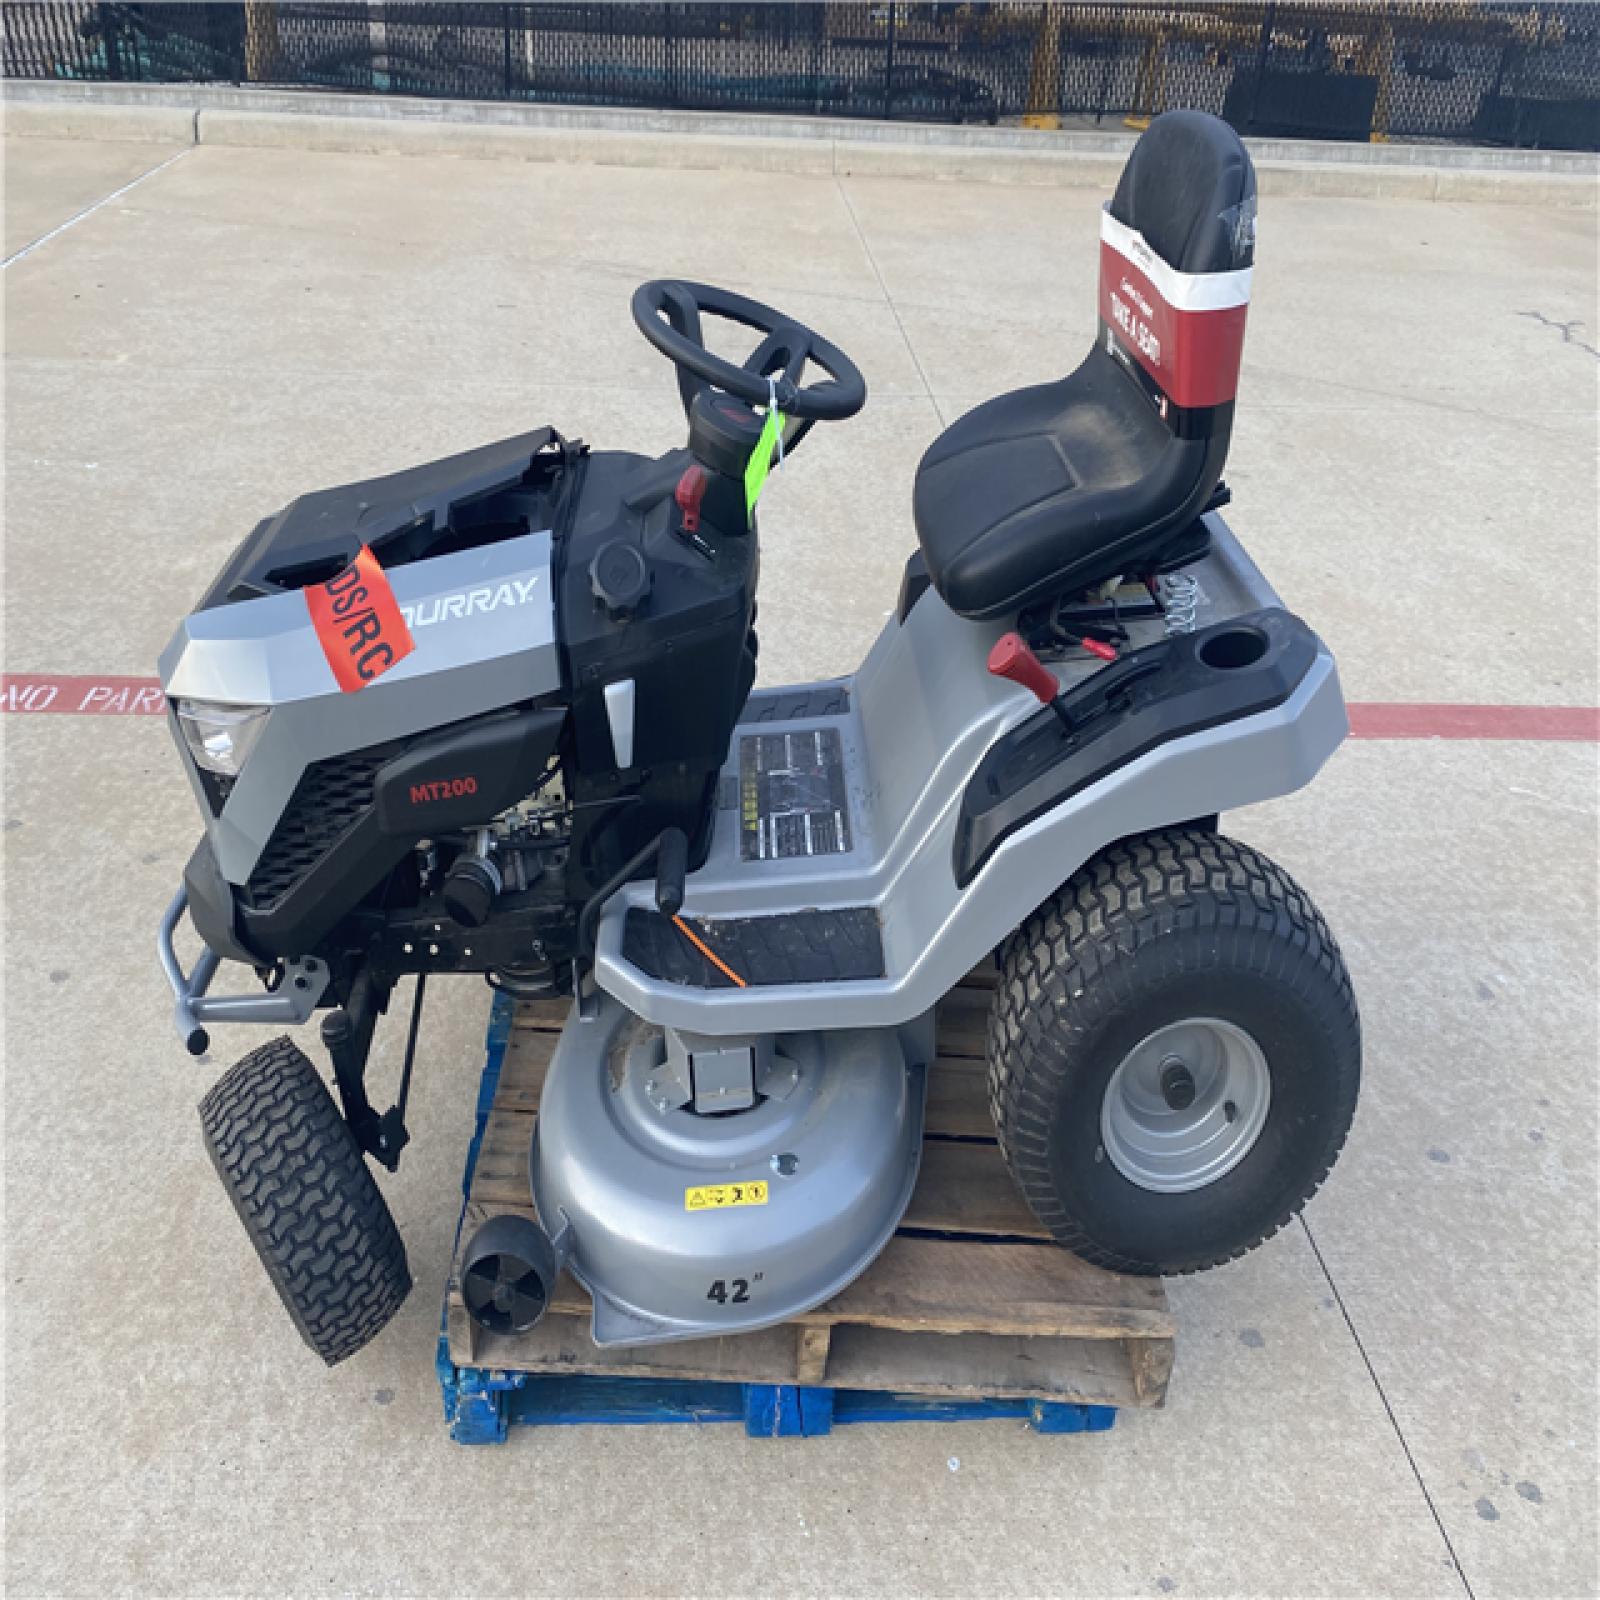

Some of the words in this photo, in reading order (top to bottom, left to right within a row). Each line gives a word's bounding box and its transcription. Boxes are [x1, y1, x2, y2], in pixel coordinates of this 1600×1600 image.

[2, 684, 58, 711] NO
[77, 686, 166, 712] PAR
[409, 776, 477, 804] MT200
